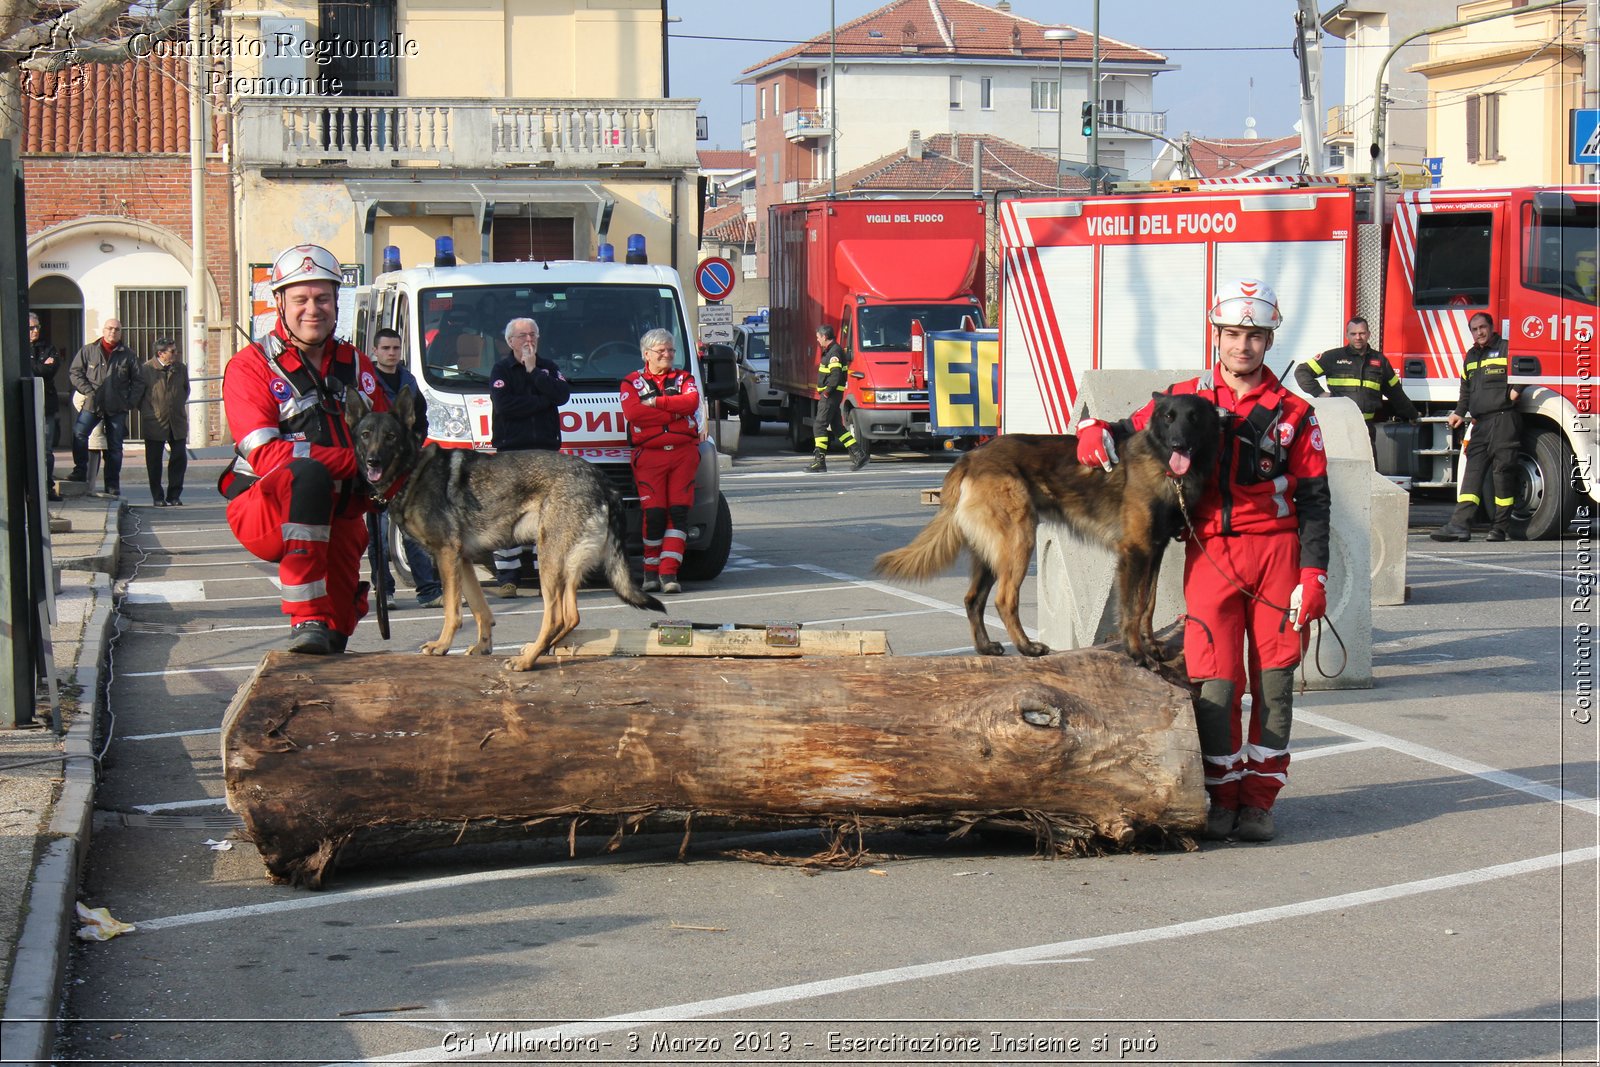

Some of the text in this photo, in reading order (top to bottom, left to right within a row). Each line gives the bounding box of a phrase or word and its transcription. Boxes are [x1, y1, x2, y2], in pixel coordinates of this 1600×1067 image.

[1434, 202, 1499, 210] www.vigilfuoco.it
[866, 213, 944, 223] VIGILI DEL FUOCO
[1086, 212, 1237, 236] VIGILI DEL FUOCO
[1547, 314, 1594, 341] 115
